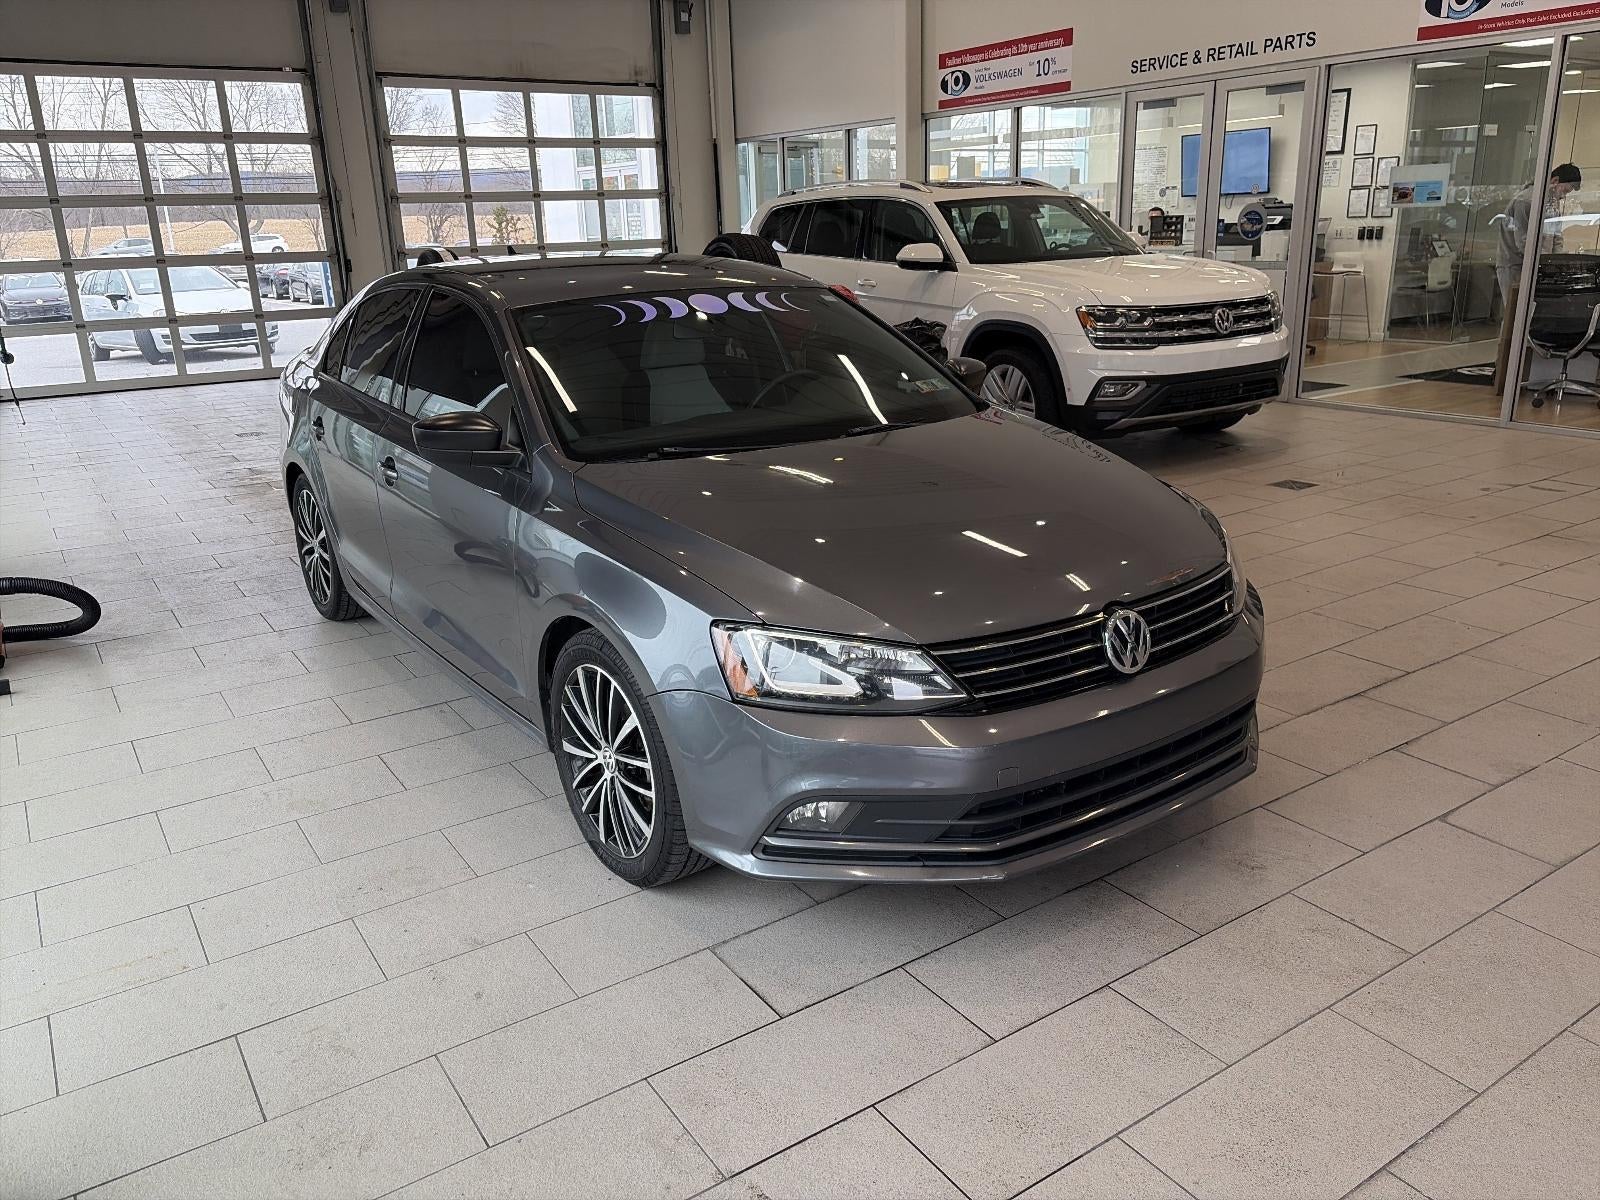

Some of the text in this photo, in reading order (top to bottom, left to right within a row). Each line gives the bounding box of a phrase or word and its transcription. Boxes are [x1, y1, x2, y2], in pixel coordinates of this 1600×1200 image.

[945, 56, 962, 66] Faulkner
[961, 53, 984, 63] Volkswagen
[989, 46, 1012, 58] Celebrating
[1018, 42, 1028, 53] 10th
[1028, 42, 1038, 53] year
[1130, 31, 1317, 74] SERVICE & RETAIL PARTS
[975, 66, 1023, 83] VOLKSWAGEN
